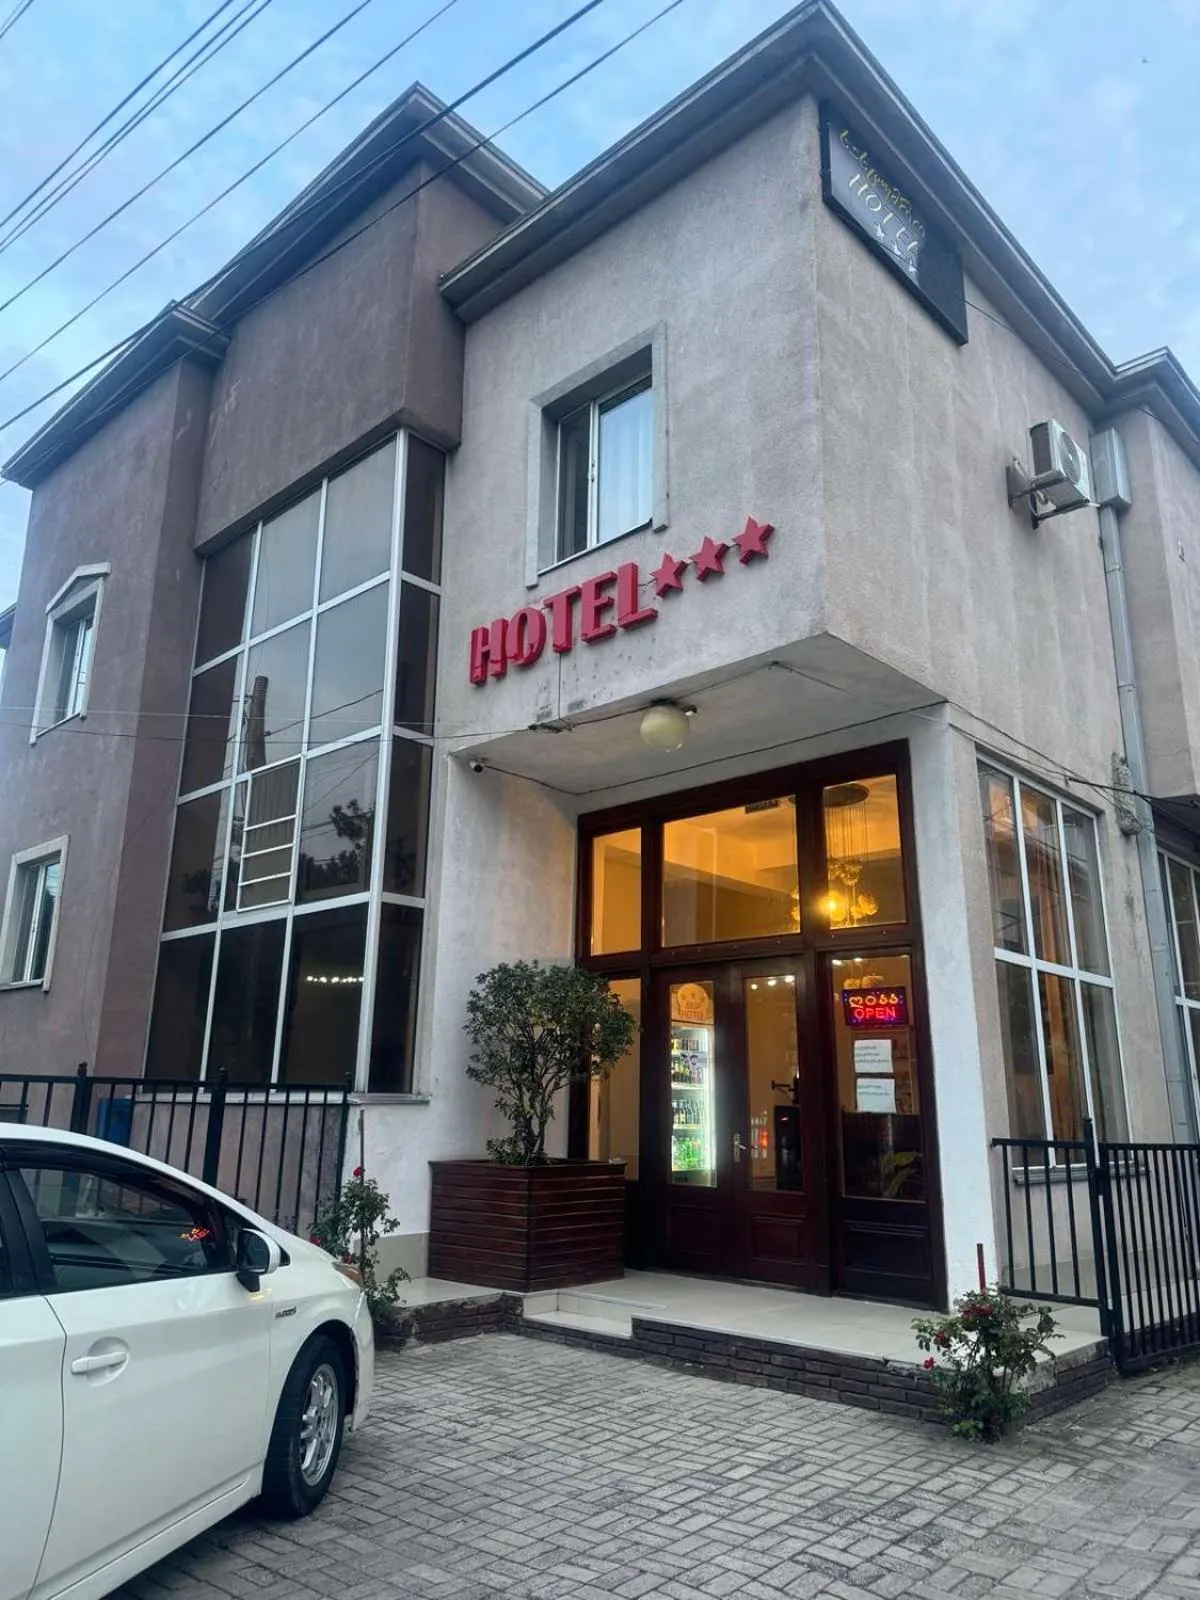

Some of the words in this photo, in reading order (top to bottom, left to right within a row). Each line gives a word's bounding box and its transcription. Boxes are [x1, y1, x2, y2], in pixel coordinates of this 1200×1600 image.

[848, 173, 919, 257] HOTEL
[469, 560, 659, 686] HOTEL
[854, 1006, 897, 1020] OPEN
